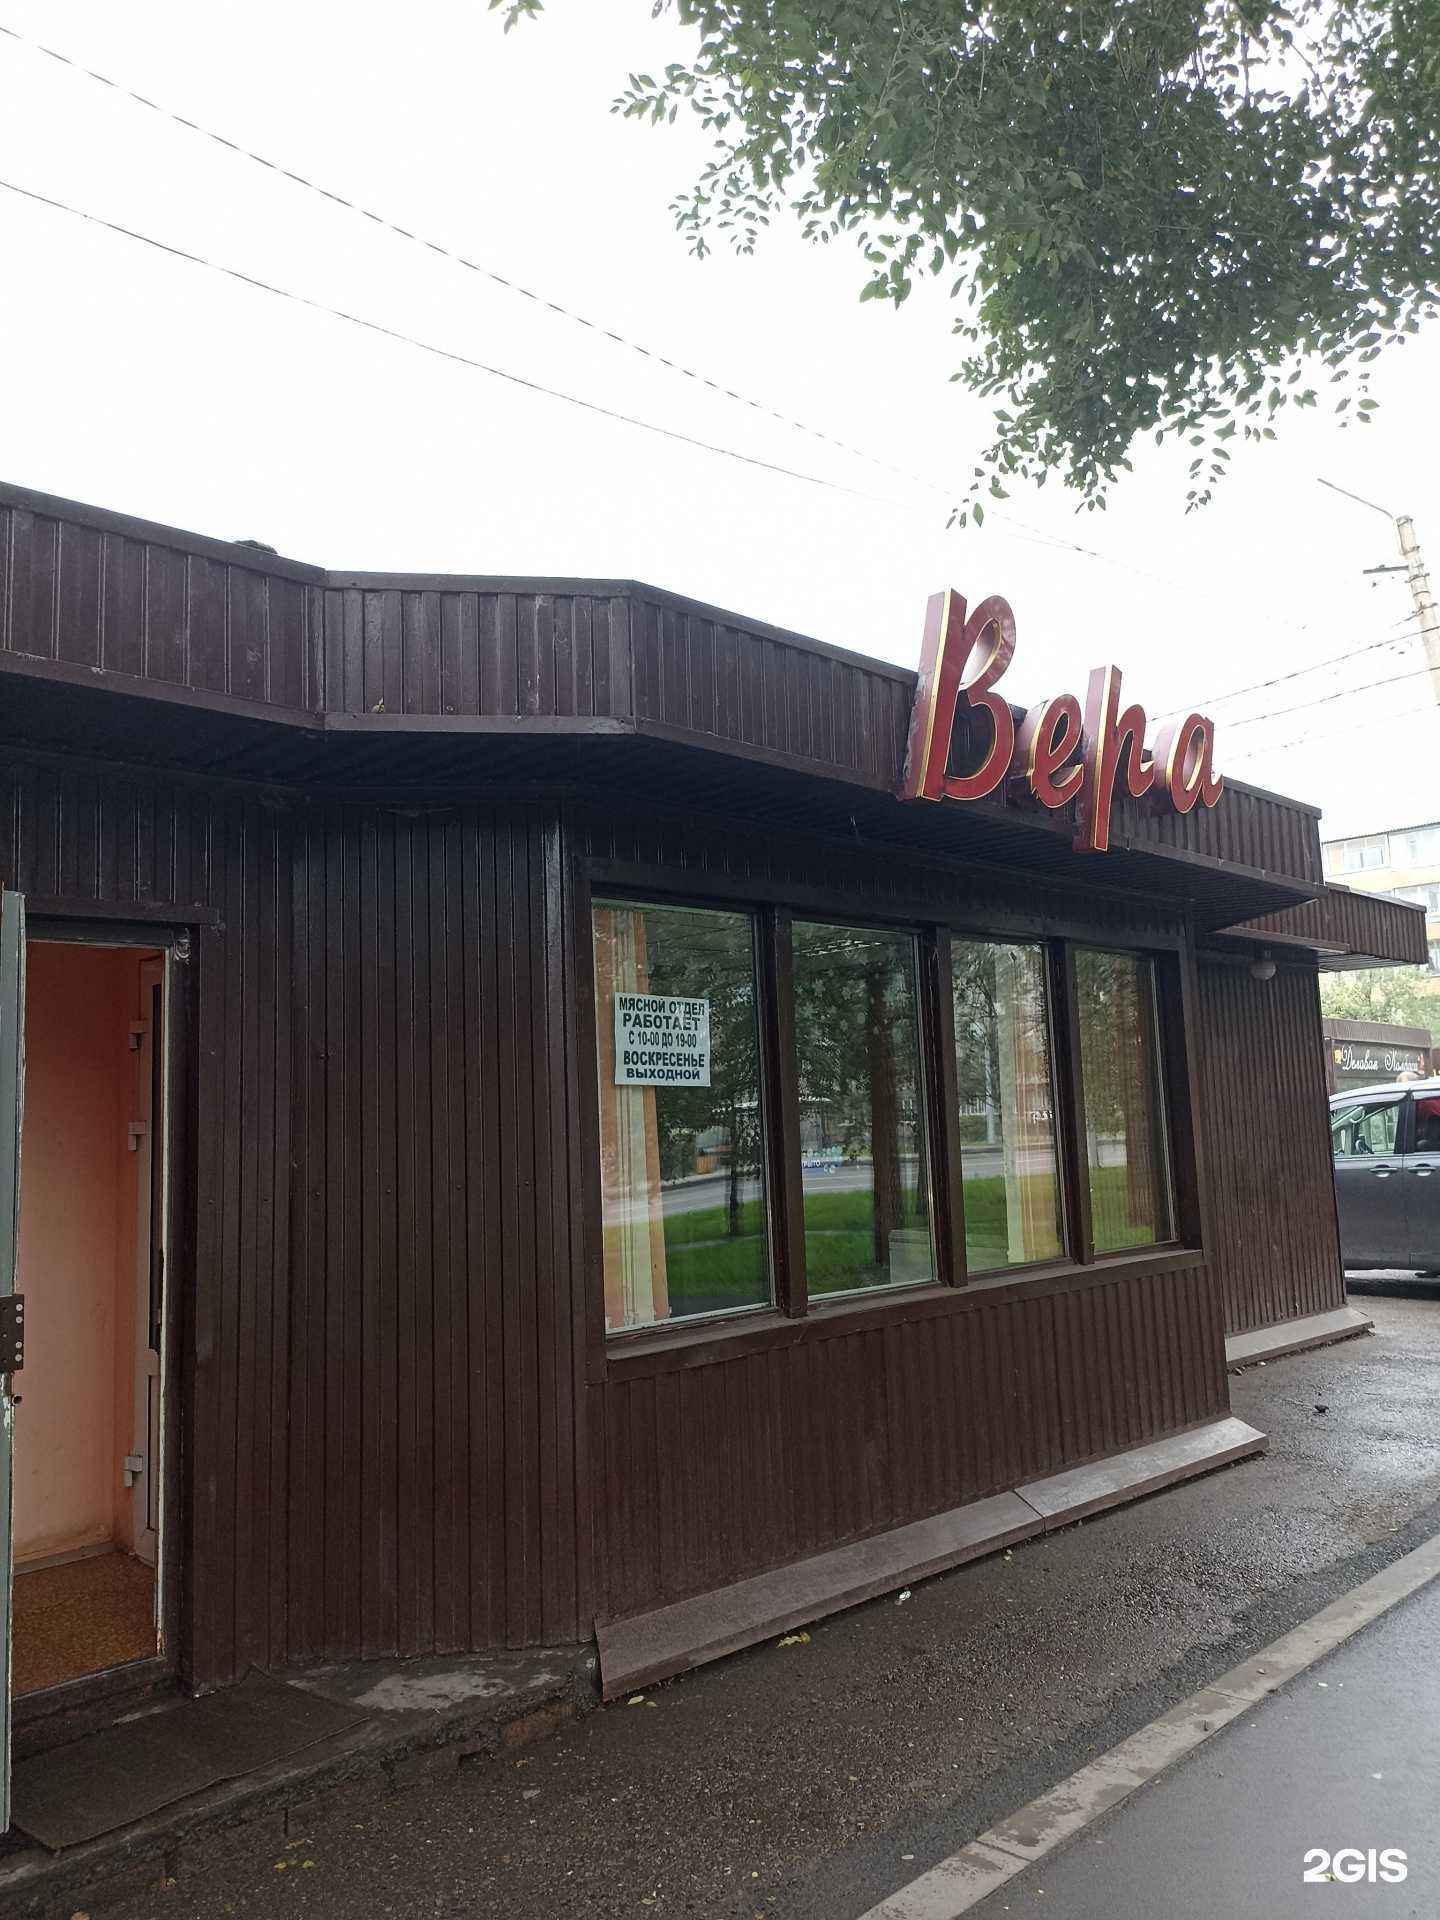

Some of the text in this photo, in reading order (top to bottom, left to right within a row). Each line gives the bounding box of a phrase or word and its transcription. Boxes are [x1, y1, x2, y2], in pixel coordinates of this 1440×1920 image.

[619, 997, 705, 1016] МЯСНОЙ ОТДЕЛ
[622, 1013, 700, 1031] РАБОТАЕТ
[628, 1031, 697, 1048] С 10-00 ДО 19-00
[623, 1050, 705, 1068] ВОСКРЕСЕНЬЕ
[626, 1067, 700, 1081] ВЫХОДНОЙ
